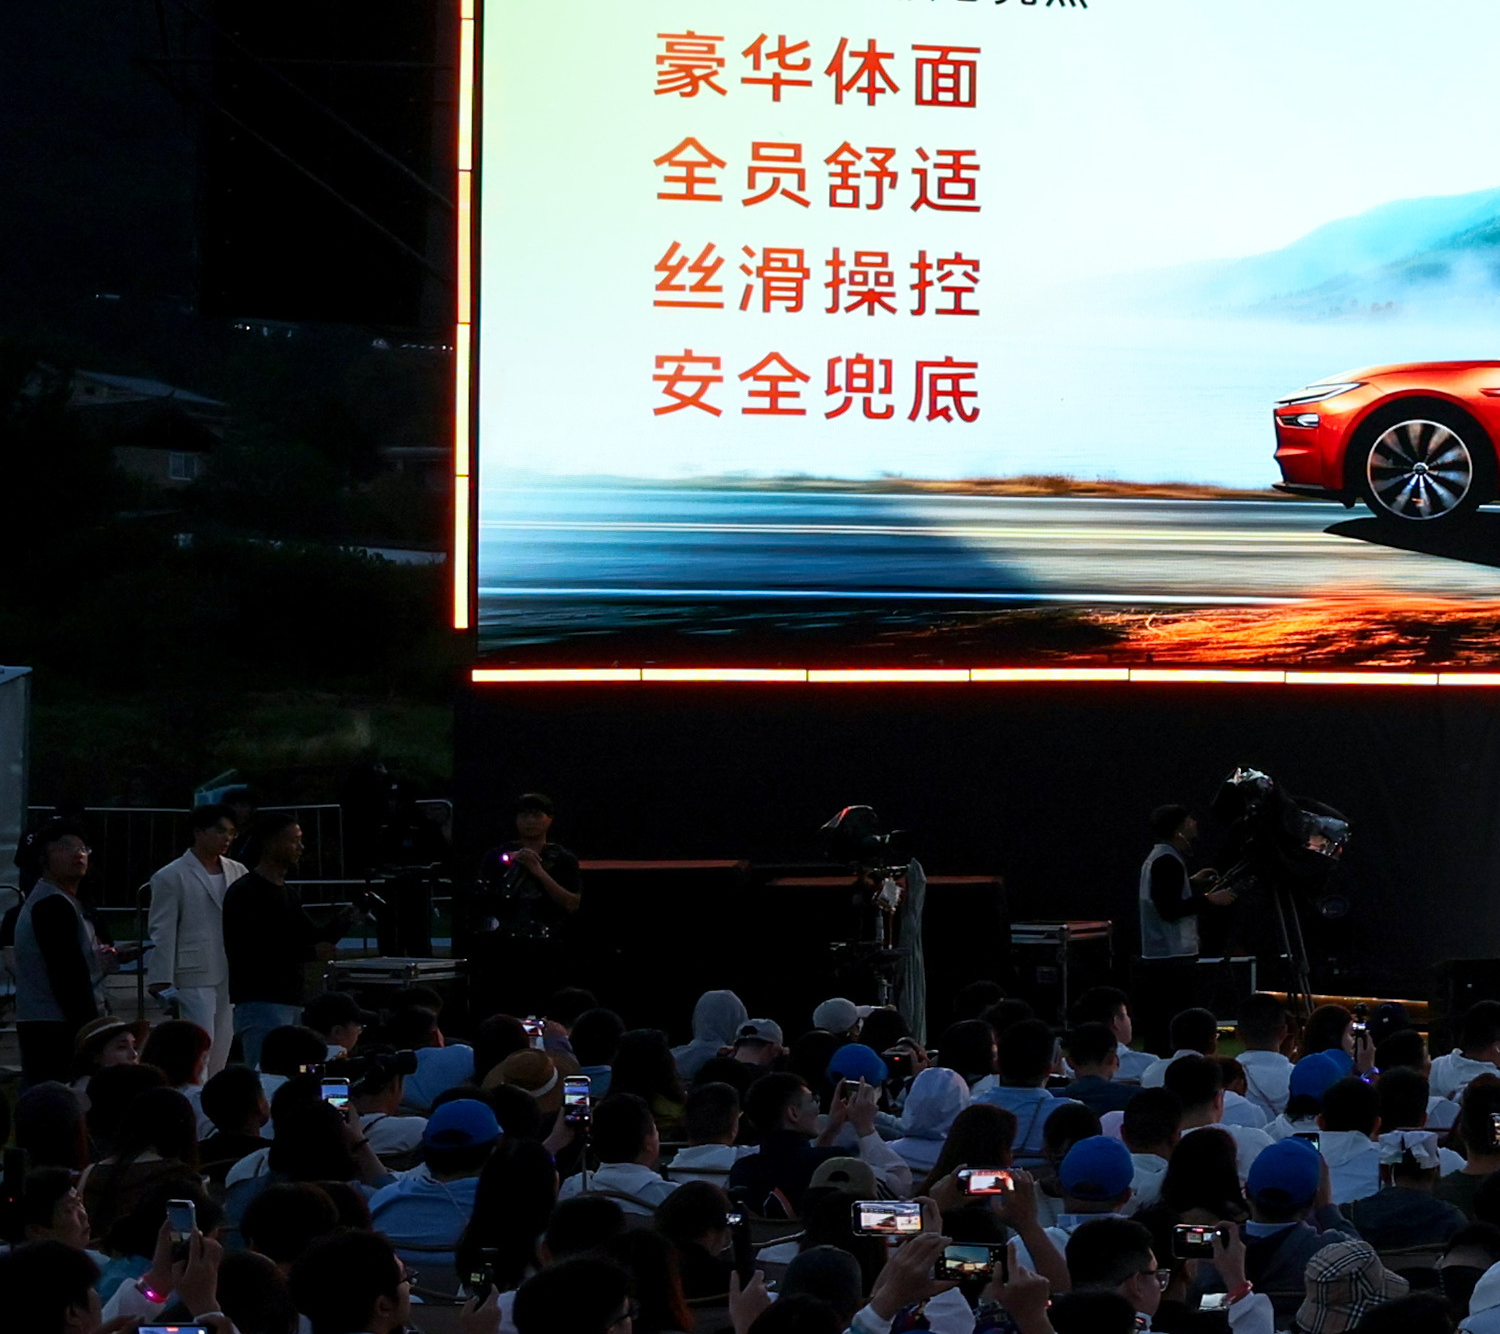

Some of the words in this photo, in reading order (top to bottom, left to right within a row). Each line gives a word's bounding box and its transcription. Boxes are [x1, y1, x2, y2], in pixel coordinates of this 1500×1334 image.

[653, 30, 981, 109] 豪华体面
[653, 137, 982, 213] 全员舒适
[653, 241, 980, 317] 丝滑操控
[652, 349, 980, 423] 安全兜底
